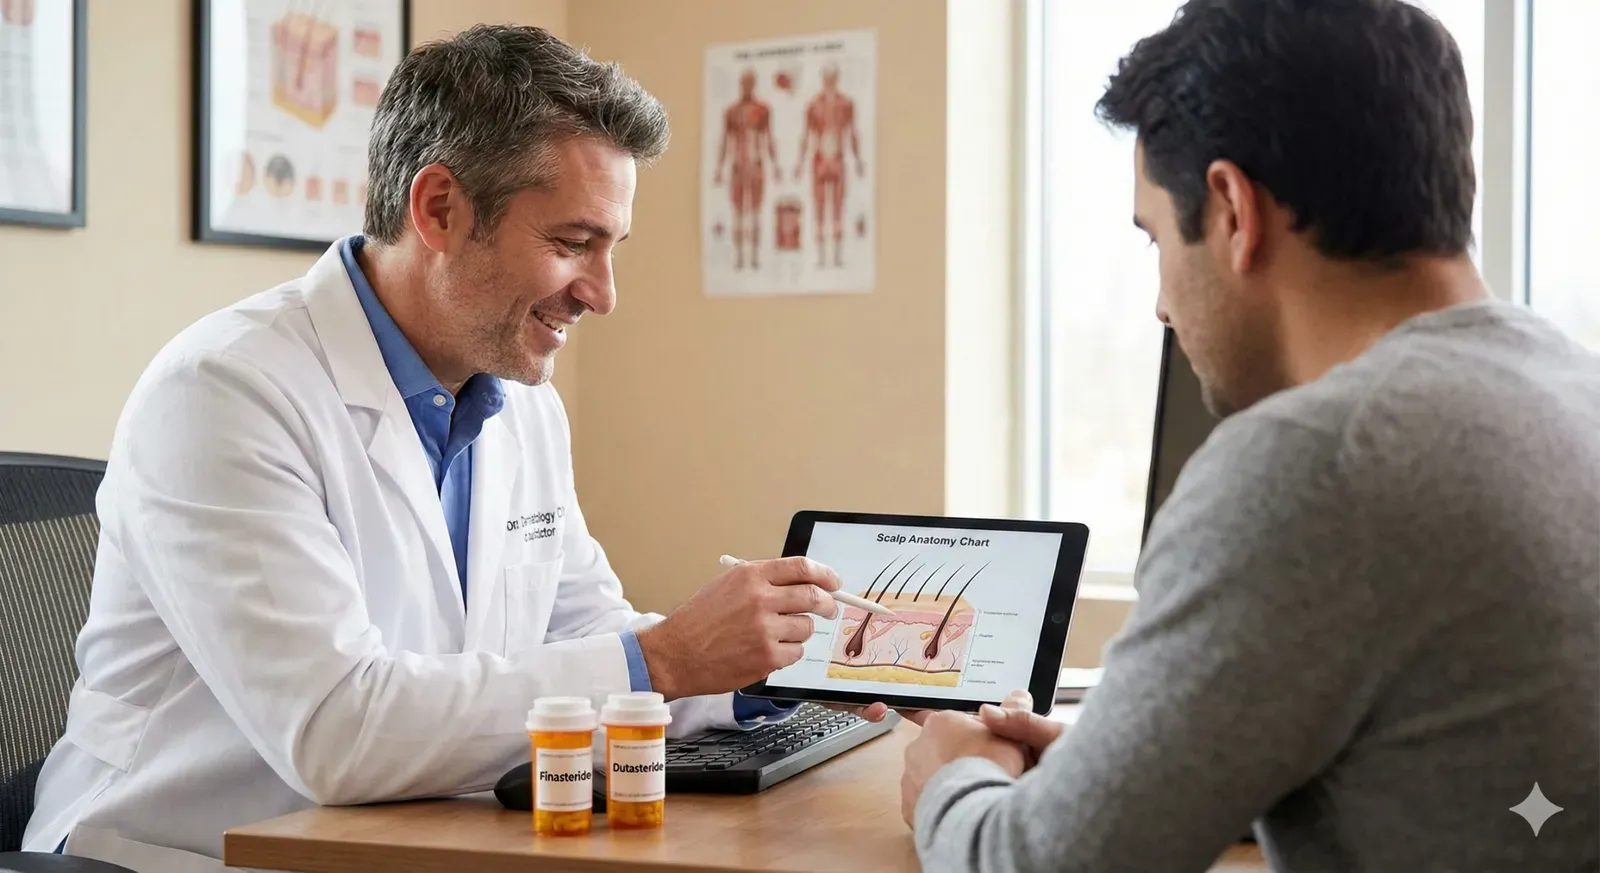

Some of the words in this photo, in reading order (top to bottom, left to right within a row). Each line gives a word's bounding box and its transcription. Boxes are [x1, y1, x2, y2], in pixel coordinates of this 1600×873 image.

[876, 533, 907, 545] Scalp
[908, 534, 957, 548] Anatomy
[959, 537, 990, 547] Chart
[612, 762, 664, 774] Dutasteride
[539, 770, 592, 783] Finasteride
